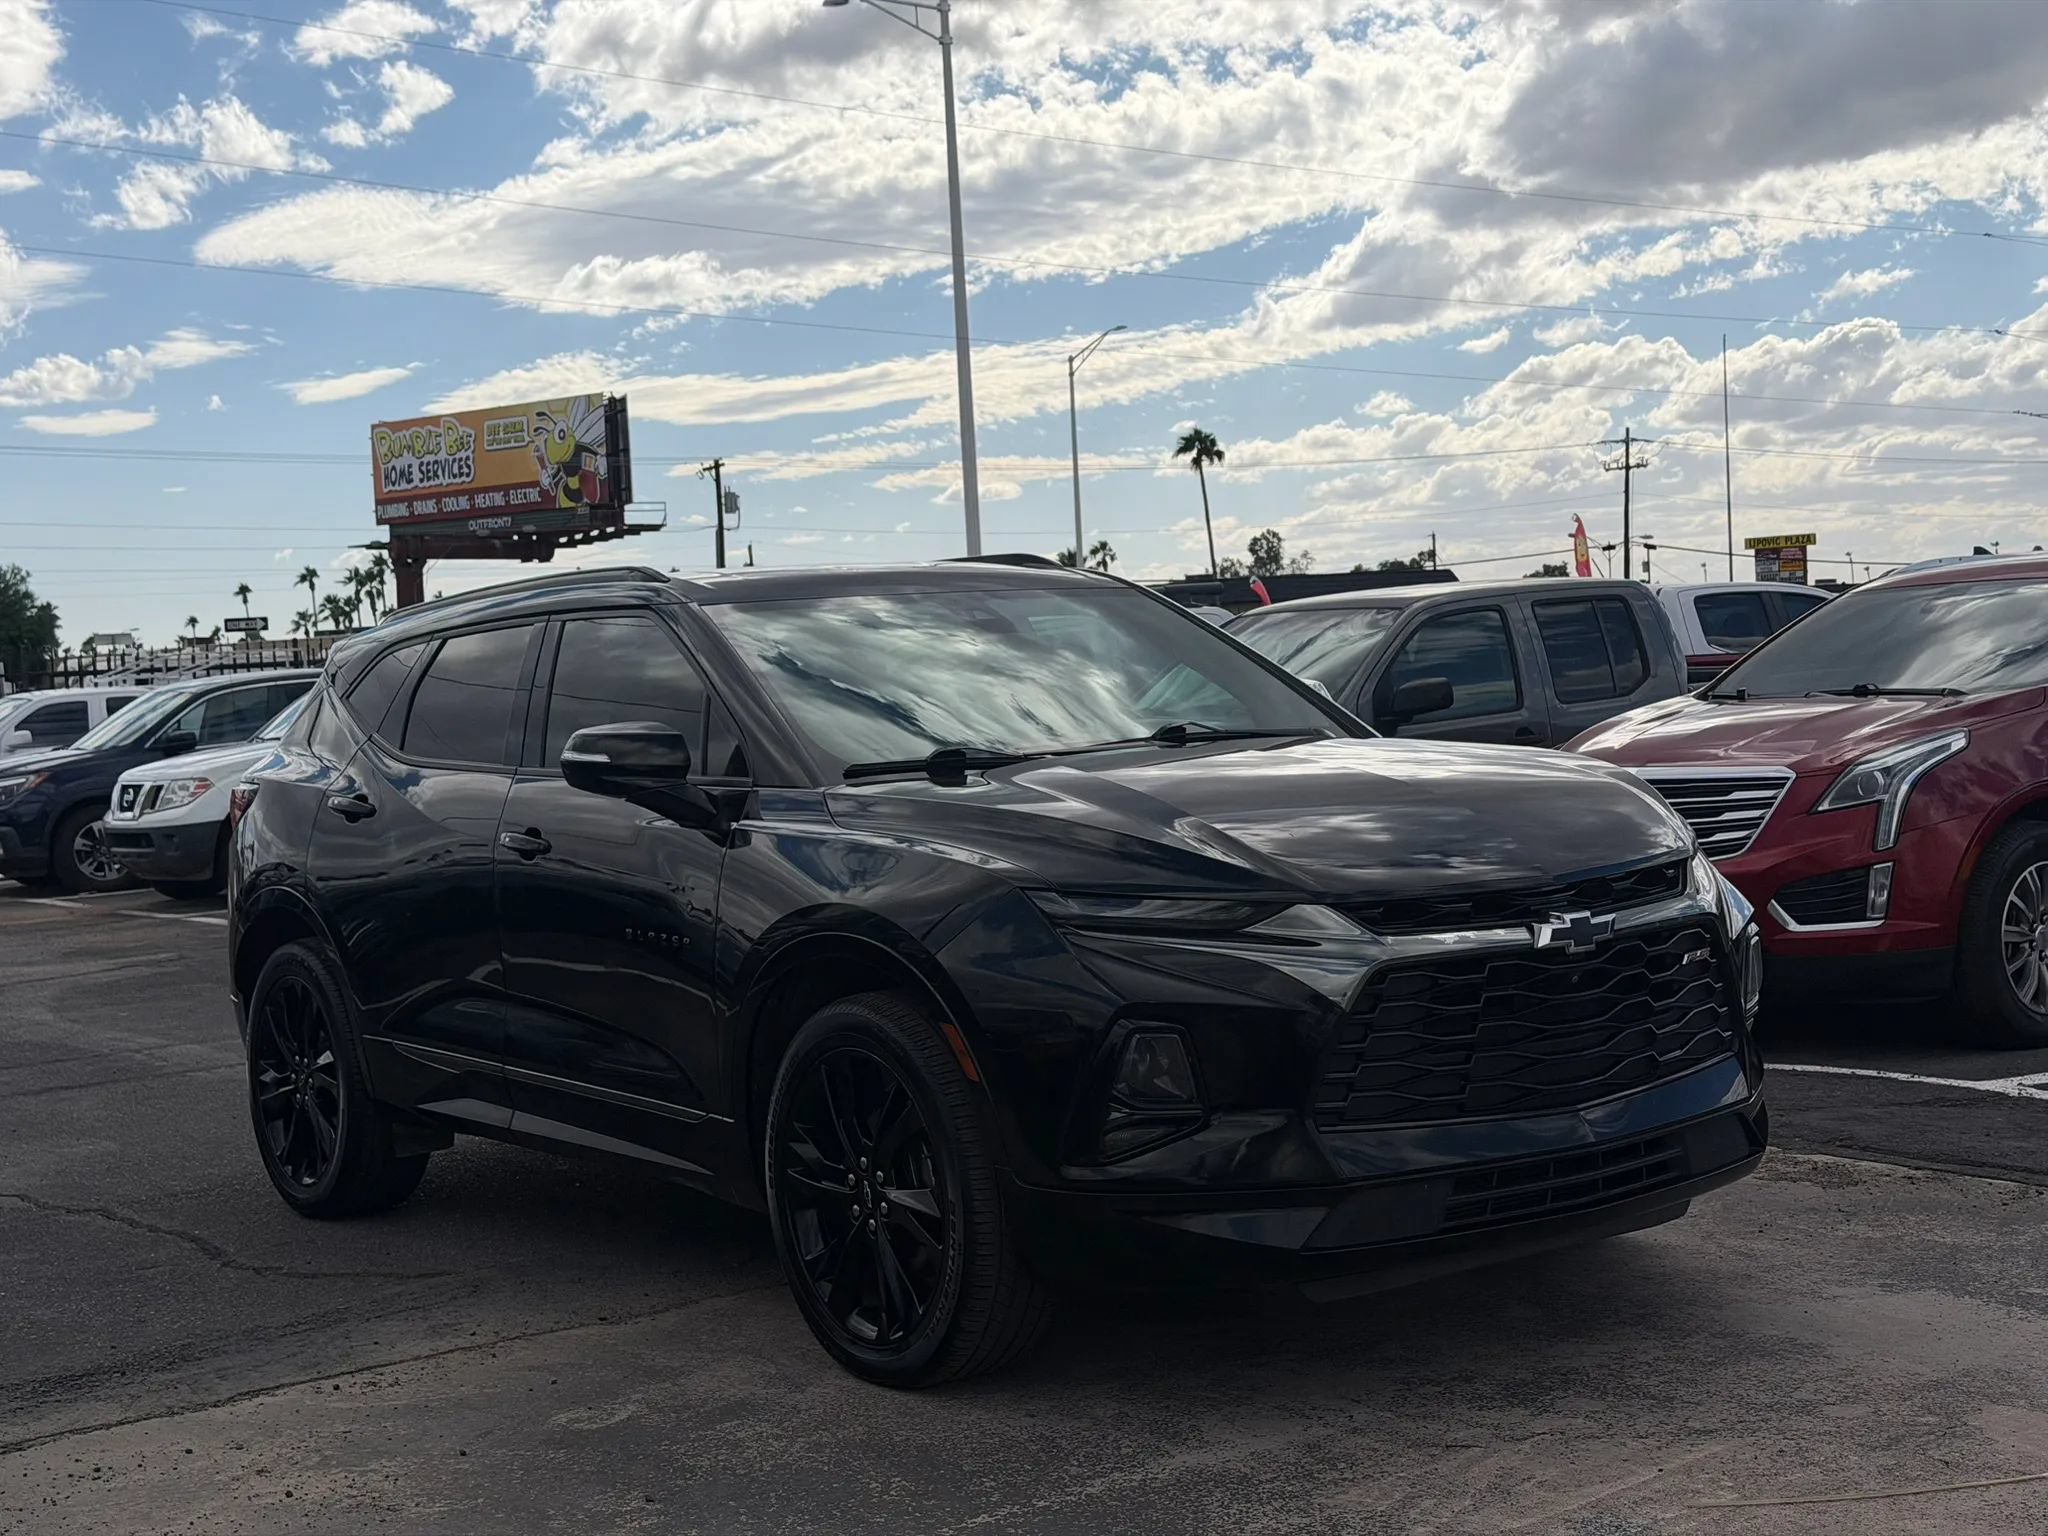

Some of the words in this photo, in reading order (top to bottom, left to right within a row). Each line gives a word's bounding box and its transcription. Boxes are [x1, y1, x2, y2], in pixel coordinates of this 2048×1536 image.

[375, 429, 442, 465] BUMBLE
[444, 421, 472, 456] BEE
[383, 463, 414, 489] HOME
[418, 455, 472, 483] SERVICES
[377, 502, 410, 519] PLUMBING
[413, 499, 438, 515] DRAINS
[441, 495, 470, 512] COOLING
[474, 491, 505, 508] HEATING
[509, 487, 541, 504] ELECTRIC
[1785, 534, 1812, 545] PLAZA
